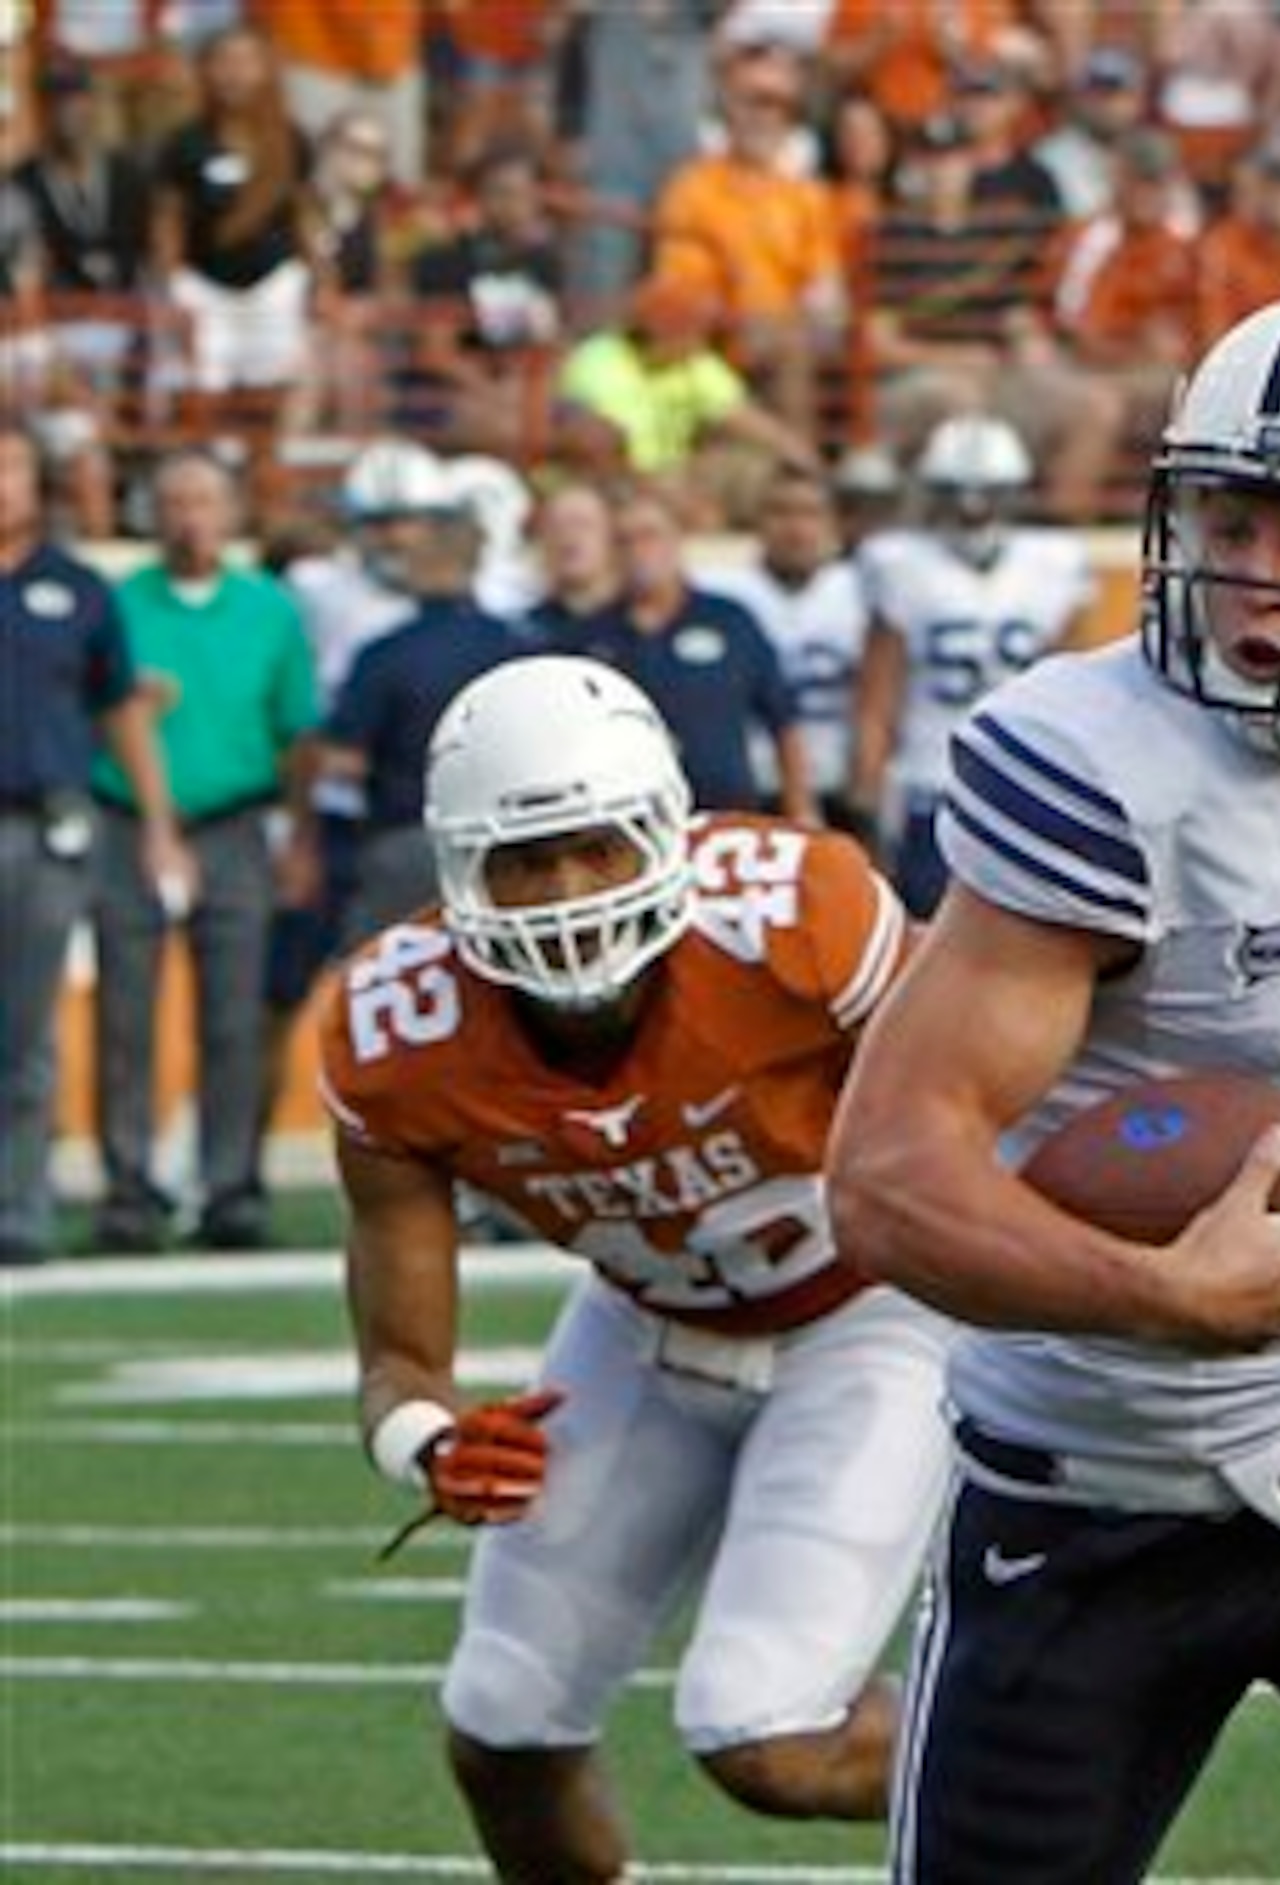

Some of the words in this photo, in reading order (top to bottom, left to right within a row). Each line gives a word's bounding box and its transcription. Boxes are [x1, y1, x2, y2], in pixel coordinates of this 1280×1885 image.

[690, 826, 806, 965] 42
[348, 923, 460, 1065] 42
[524, 1131, 760, 1222] TEXAS
